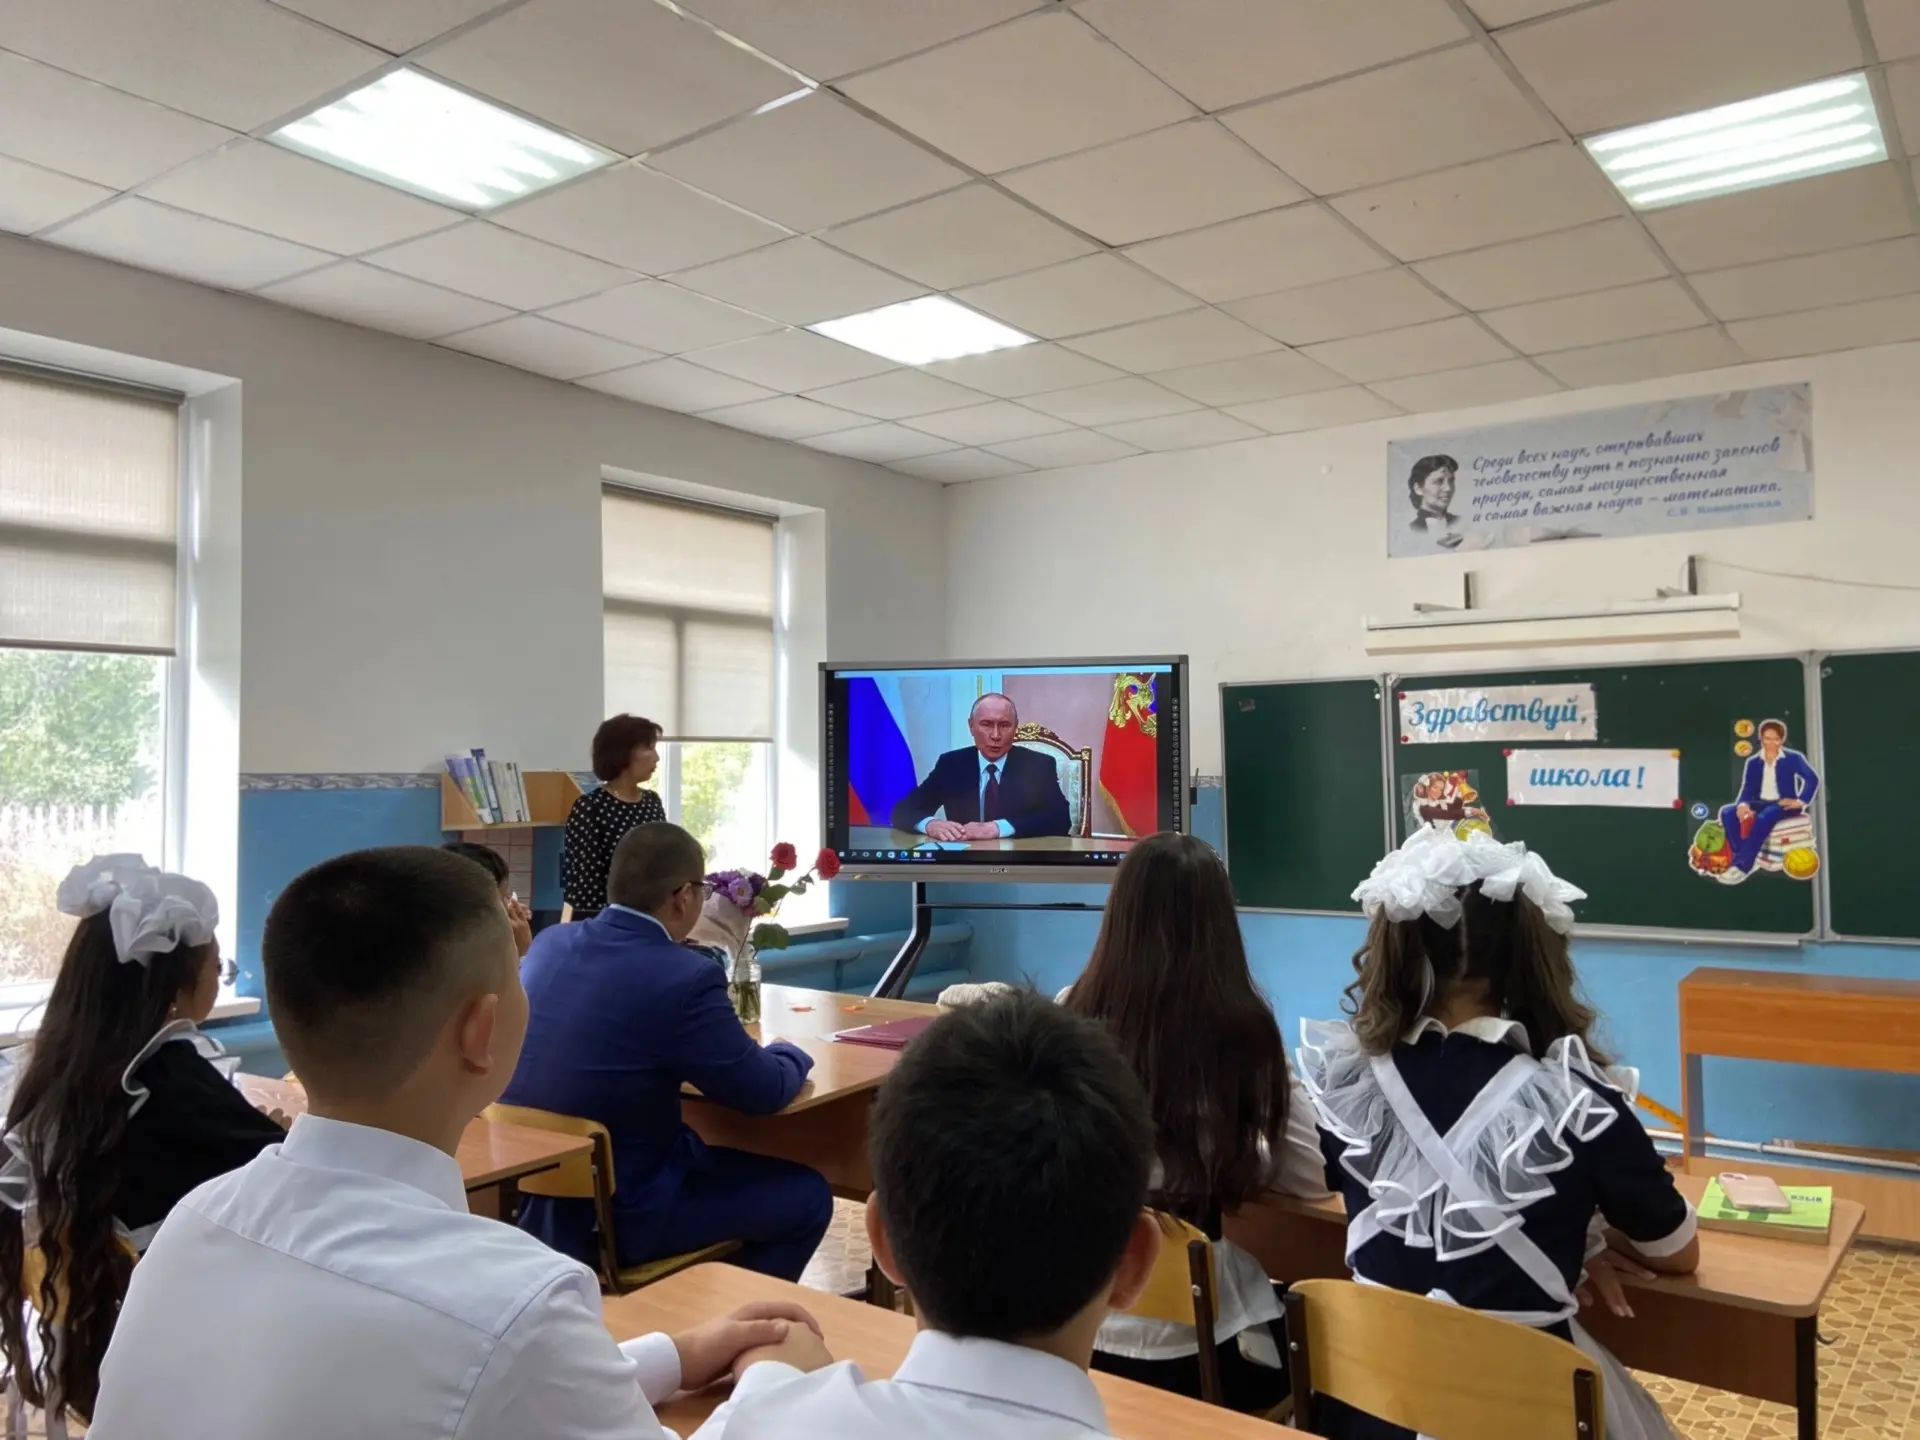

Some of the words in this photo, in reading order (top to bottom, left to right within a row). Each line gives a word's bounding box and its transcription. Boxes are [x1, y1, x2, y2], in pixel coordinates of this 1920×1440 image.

[1473, 456, 1513, 473] Среди
[1518, 449, 1547, 465] всех
[1551, 447, 1590, 464] наук,
[1596, 430, 1705, 459] открывавших
[1473, 463, 1569, 487] человечеству
[1572, 462, 1611, 480] путь
[1615, 459, 1624, 471] к
[1628, 450, 1710, 473] познанию
[1712, 436, 1781, 465] законов
[1473, 490, 1533, 510] природы,
[1538, 483, 1584, 498] самая
[1588, 468, 1728, 495] могущественная
[1473, 512, 1481, 522] и
[1484, 508, 1528, 522] самая
[1533, 501, 1593, 517] важная
[1597, 495, 1643, 514] наука
[1664, 481, 1782, 503] математика.
